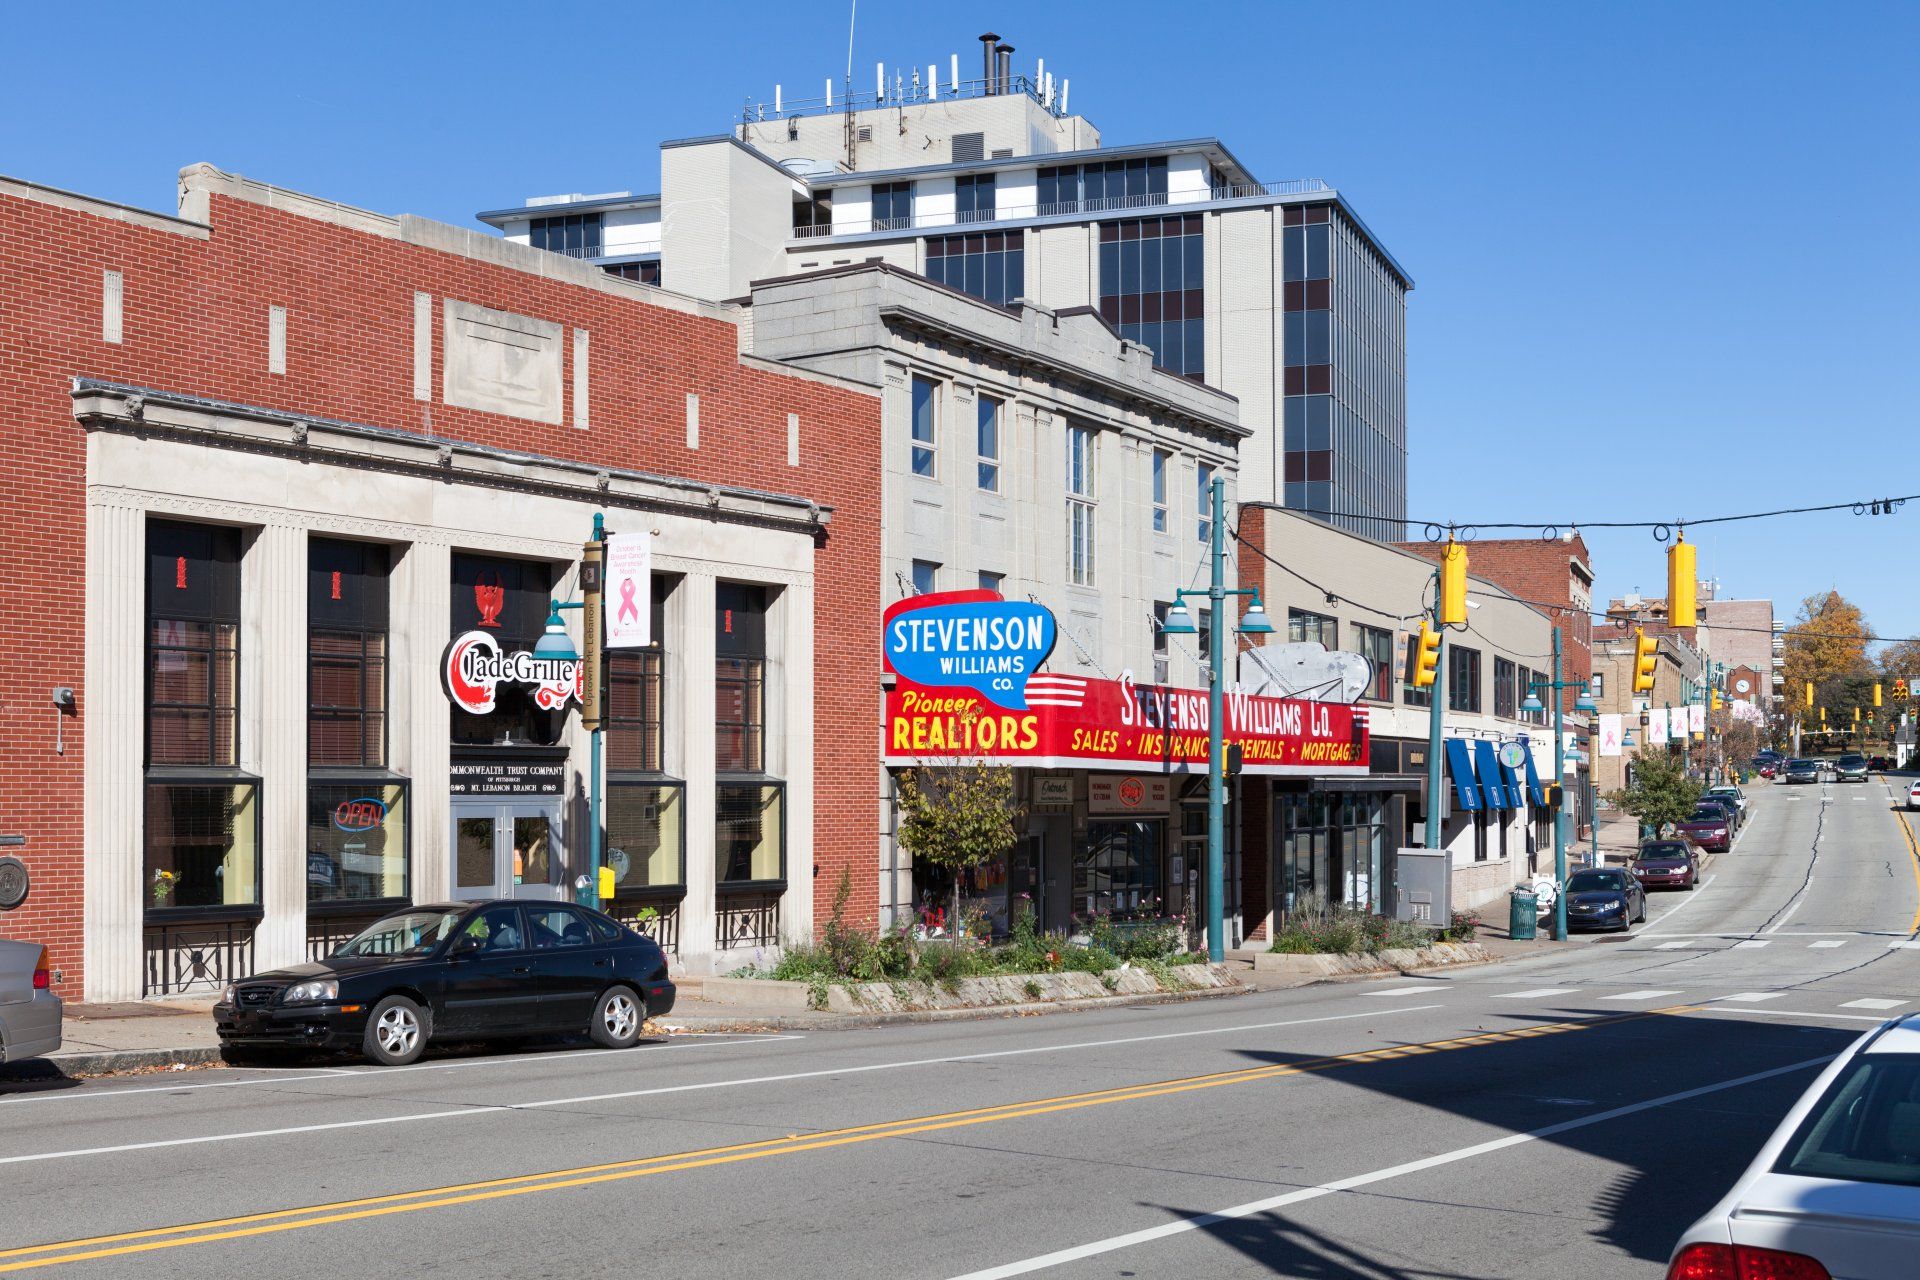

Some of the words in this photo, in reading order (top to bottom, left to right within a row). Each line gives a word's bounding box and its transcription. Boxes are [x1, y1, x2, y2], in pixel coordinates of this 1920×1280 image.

[587, 603, 595, 645] Lebanon
[893, 615, 1043, 653] STEVENSON
[940, 655, 1024, 674] WILLIAMS
[586, 666, 595, 707] Uptown
[992, 678, 1014, 690] CO.
[902, 690, 977, 713] Pioneer
[1122, 668, 1209, 731] STEVENSO
[1226, 681, 1301, 736] WILLIAMS
[893, 715, 1038, 750] REALTORS
[1072, 728, 1119, 752] SALES
[1138, 733, 1209, 758] INSURANC
[1301, 741, 1362, 761] MORTGAGES
[507, 766, 528, 775] TRUST
[530, 766, 564, 775] COMPANY
[483, 784, 510, 792] LEBANON
[513, 784, 537, 792] BRANCH
[335, 801, 382, 827] OPEN
